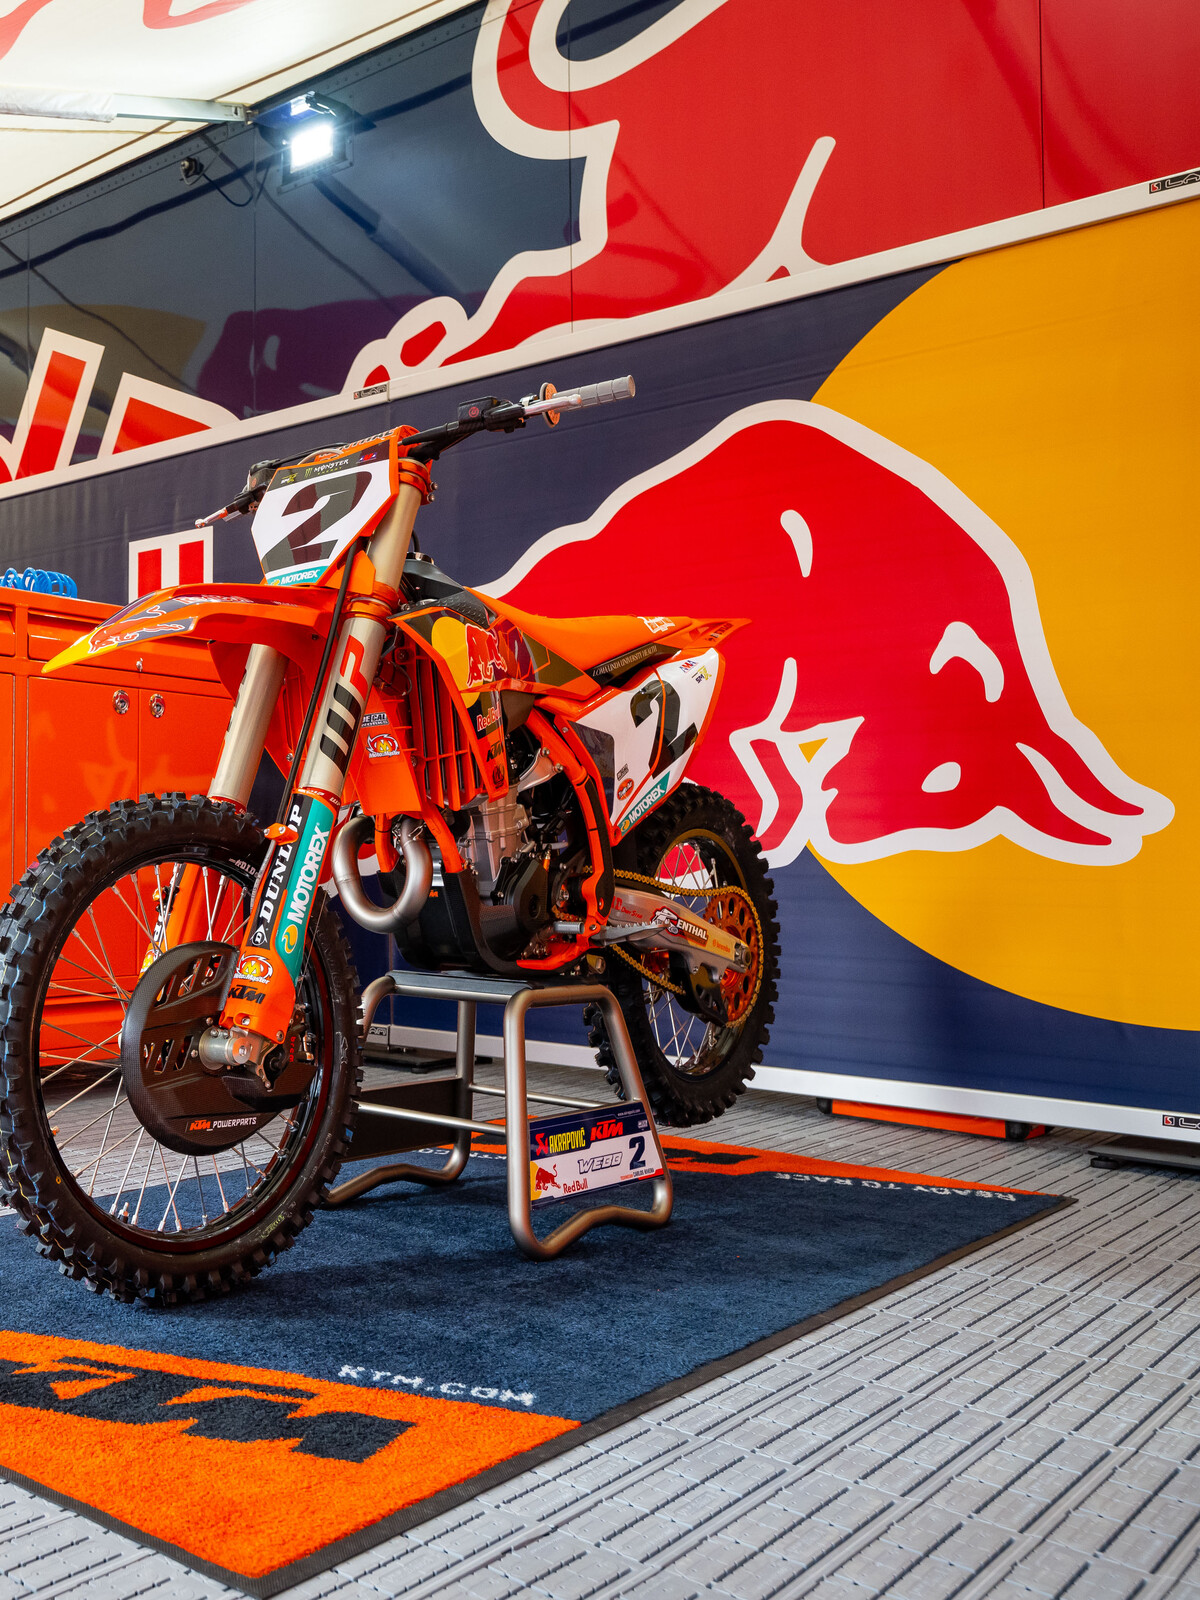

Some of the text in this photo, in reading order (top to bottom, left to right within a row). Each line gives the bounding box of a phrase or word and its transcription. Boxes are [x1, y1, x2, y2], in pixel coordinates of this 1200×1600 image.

[313, 459, 350, 474] MONSTER
[261, 471, 373, 575] 2
[281, 569, 320, 584] MOTOREX
[630, 680, 699, 779] 2
[628, 784, 665, 823] MOTOREX
[287, 825, 329, 924] MOTOREX
[228, 984, 266, 1004] KTM
[289, 1036, 297, 1062] brem
[189, 1116, 257, 1131] KTM POWERPARTS
[590, 1119, 623, 1141] KTM
[578, 1152, 623, 1174] WEBB
[629, 1136, 646, 1170] 2
[563, 1178, 588, 1194] Red Bull
[338, 1364, 536, 1406] KTM.COM
